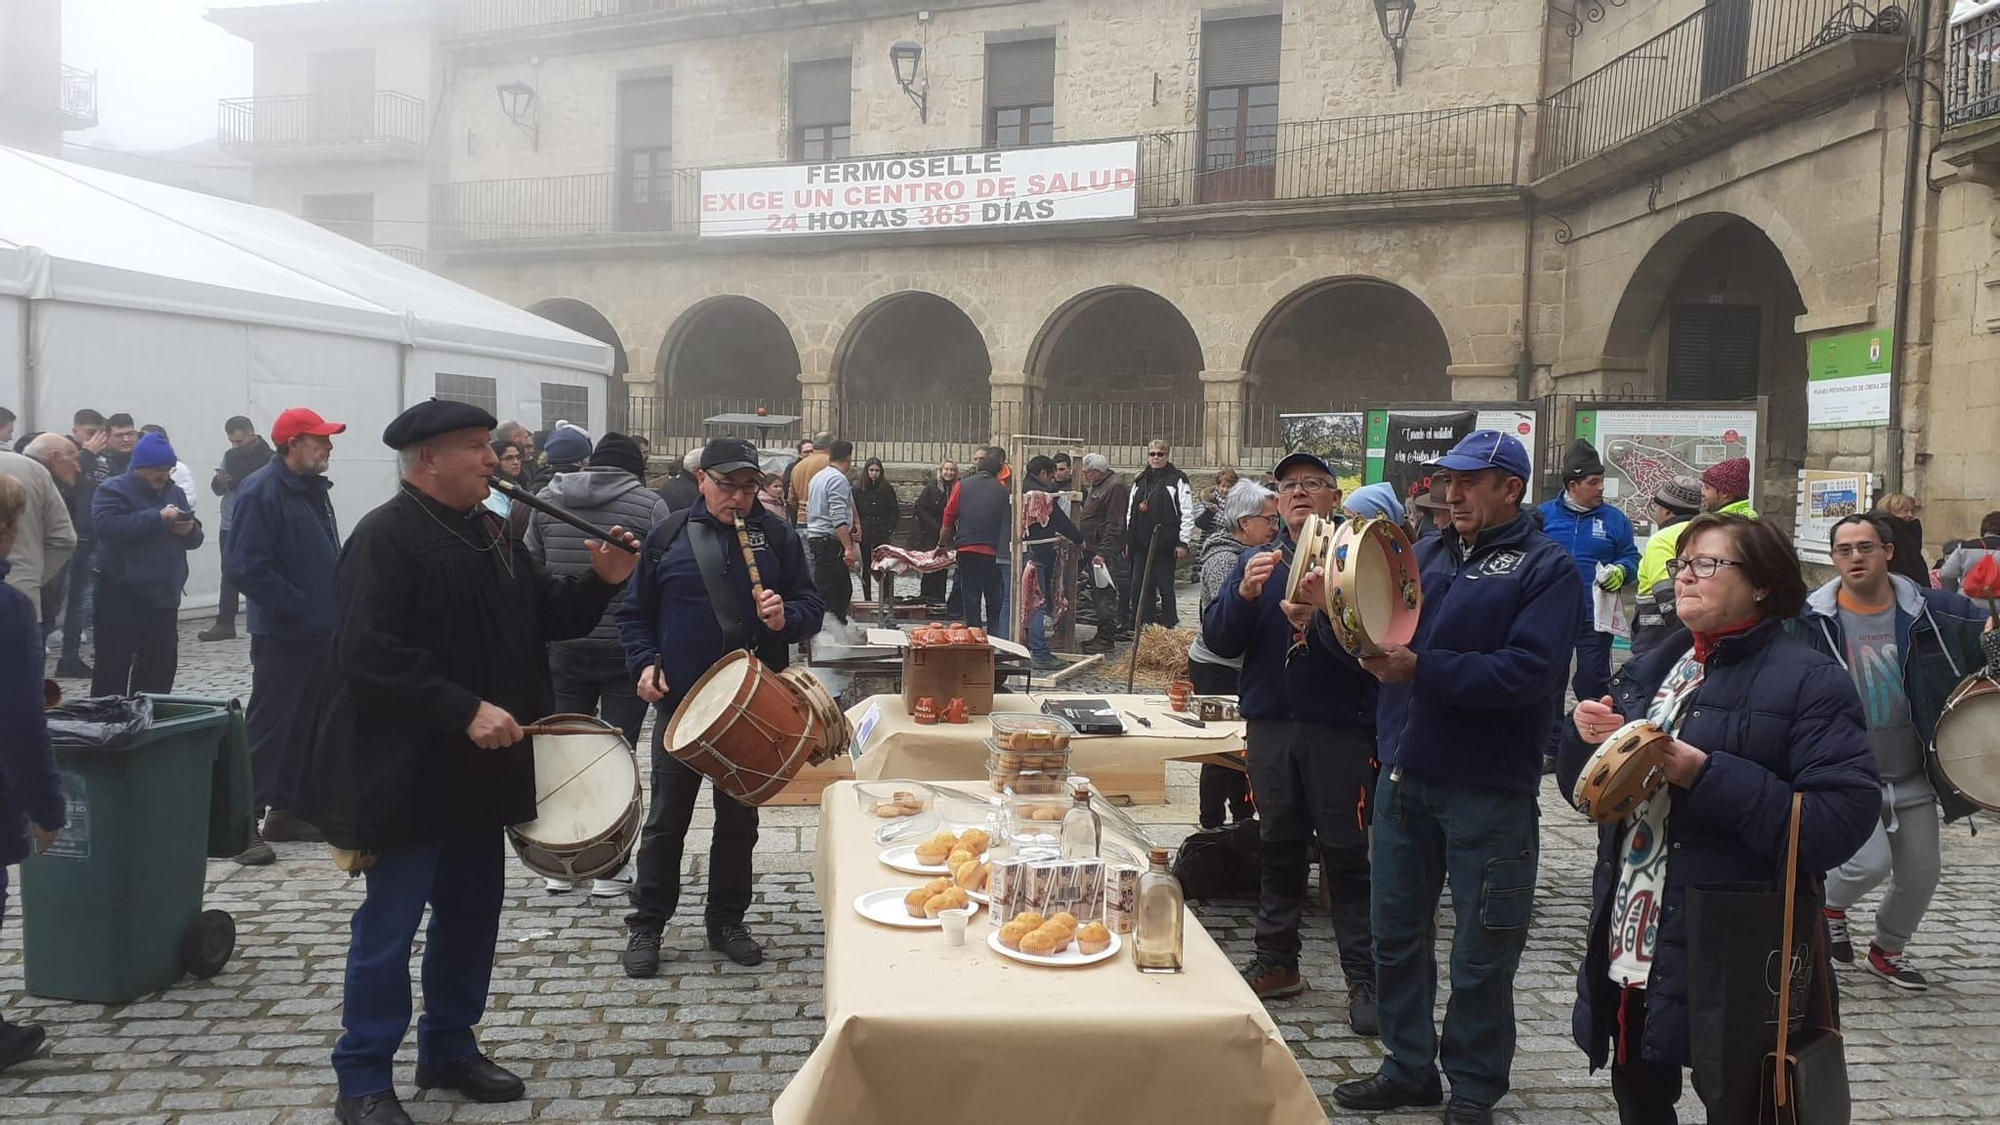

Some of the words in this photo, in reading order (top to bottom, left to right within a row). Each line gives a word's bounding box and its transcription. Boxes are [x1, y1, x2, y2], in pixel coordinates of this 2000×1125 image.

[807, 152, 1002, 185] FERMOSELLE
[702, 189, 784, 213] EXIGE
[794, 188, 834, 209] UN
[844, 180, 965, 207] CENTRO
[976, 176, 1016, 199] DE
[1026, 168, 1137, 196] SALUD
[766, 213, 798, 233] 24
[808, 207, 907, 231] HORAS
[918, 204, 970, 226] 365
[982, 197, 1055, 223] DÍAS
